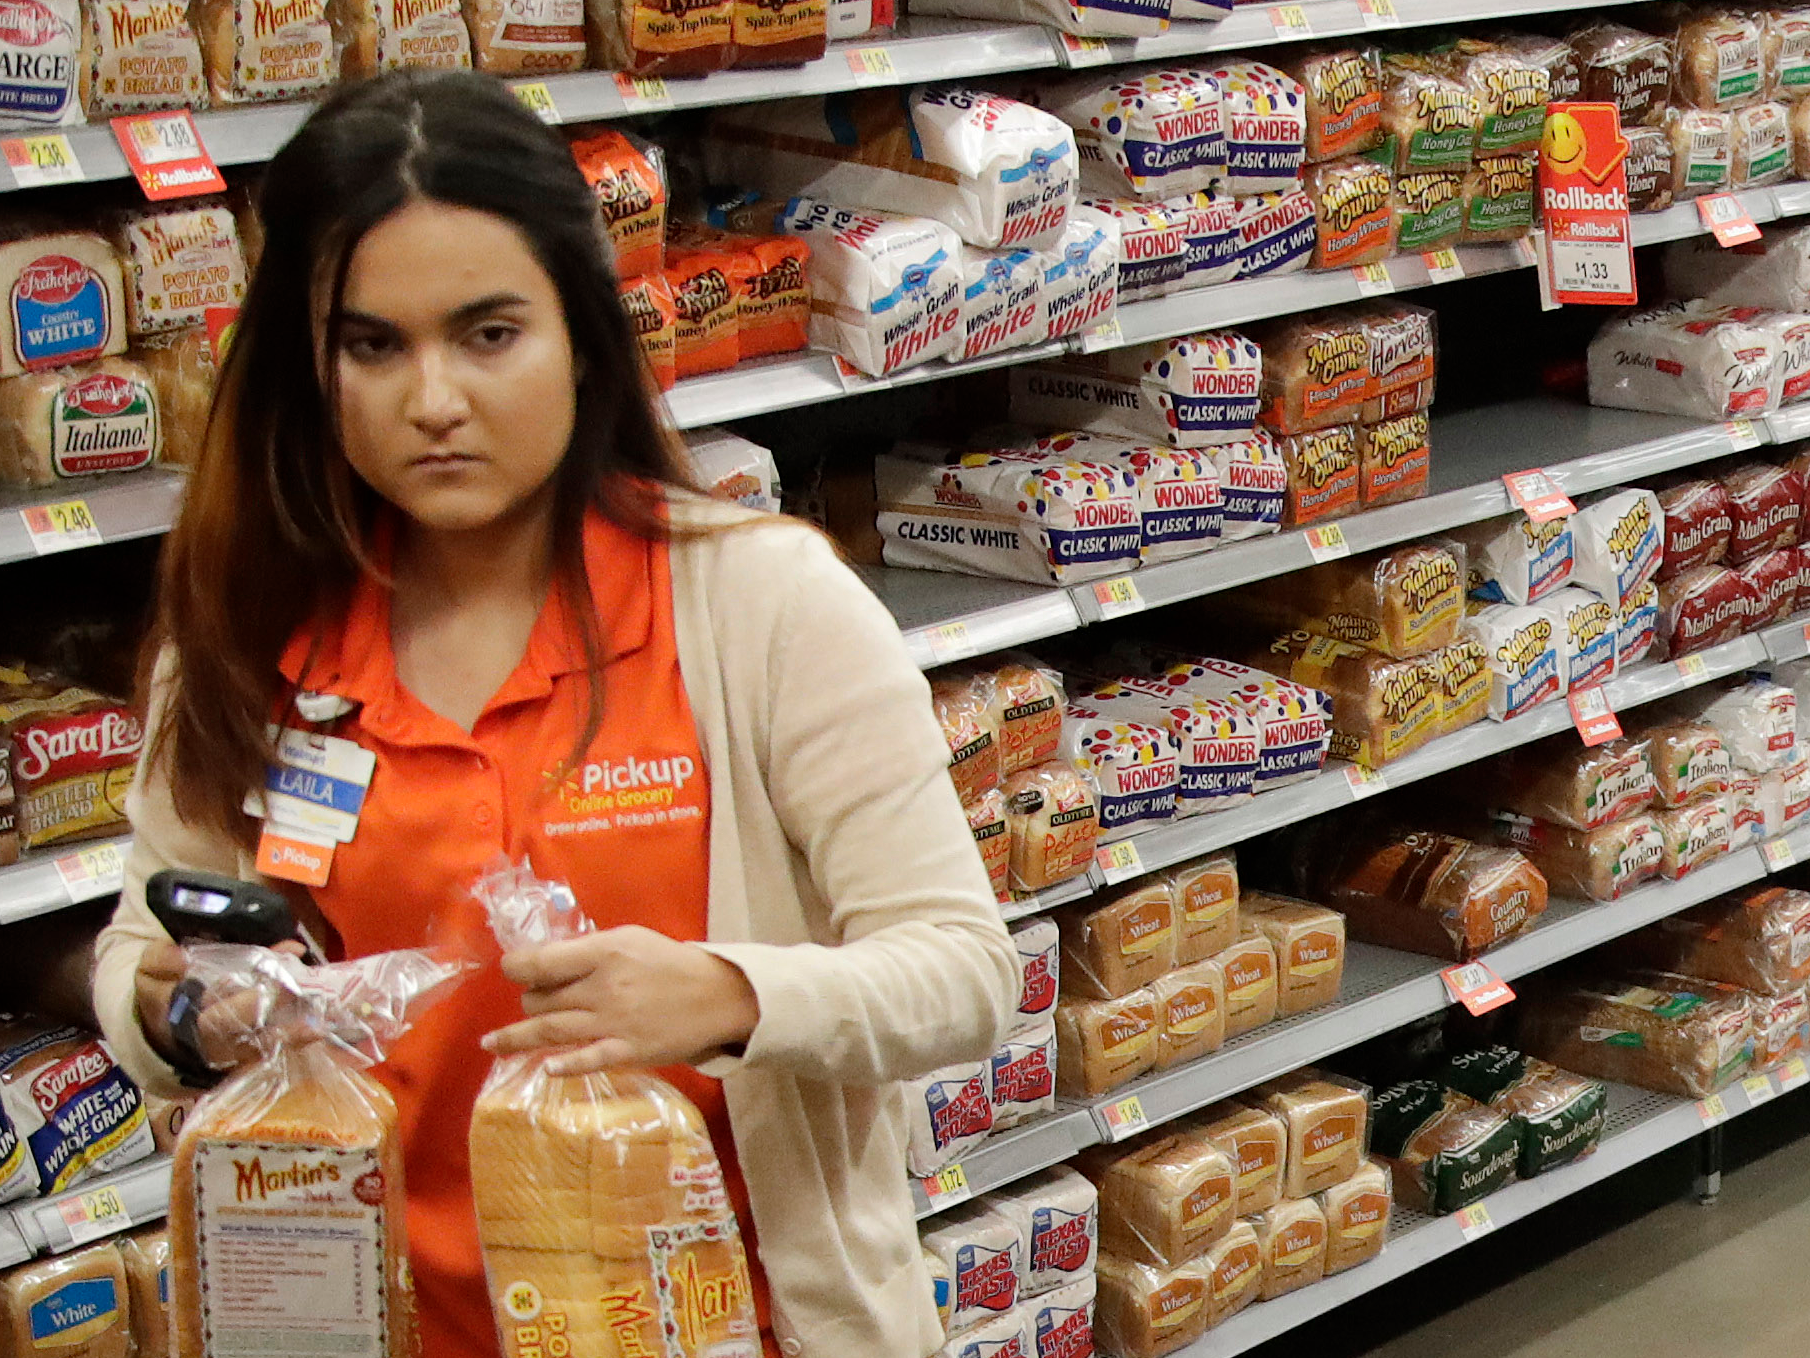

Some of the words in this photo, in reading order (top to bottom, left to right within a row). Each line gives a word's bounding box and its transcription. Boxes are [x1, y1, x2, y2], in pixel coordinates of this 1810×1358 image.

[260, 41, 322, 63] POTATO
[401, 35, 458, 55] POTATO
[0, 52, 68, 84] ARGE
[119, 56, 188, 74] POTATO
[263, 60, 319, 81] BREAD
[123, 77, 184, 94] BREAD
[1155, 108, 1220, 142] WONDER
[1231, 119, 1300, 142] WONDER
[1493, 116, 1526, 135] Honey
[1227, 149, 1266, 167] LASSIC
[160, 166, 216, 187] Rollback
[1628, 174, 1657, 193] Honey
[1005, 195, 1040, 219] Whole
[1041, 178, 1070, 204] Grain
[1480, 199, 1512, 218] Honey
[1544, 187, 1627, 210] Rollback
[1000, 205, 1066, 247] White
[1240, 195, 1314, 243] WONDER
[1412, 214, 1440, 233] Honey
[1570, 222, 1620, 237] Rollback
[20, 264, 90, 298] Freihofer's
[163, 266, 230, 291] POTATO
[1575, 262, 1609, 279] $1.33
[170, 286, 228, 309] BREAD
[965, 301, 1004, 335] Whole
[1006, 278, 1039, 309] Grain
[1047, 288, 1086, 318] Whole
[884, 308, 924, 345] Whole
[925, 282, 960, 315] Grain
[28, 317, 95, 346] WHITE
[883, 306, 960, 374] White
[964, 302, 1037, 359] White
[1369, 329, 1430, 376] Harvest
[1027, 379, 1091, 401] CLASSIC
[1097, 387, 1140, 410] WHITE
[1192, 371, 1257, 395] WONDER
[1178, 405, 1223, 422] CLASSIC
[1226, 404, 1258, 420] WHITE
[65, 417, 149, 453] Italiano!
[1155, 483, 1221, 508] WONDER
[1074, 501, 1139, 529] WONDER
[1739, 516, 1768, 540] Multi
[1769, 499, 1799, 525] Grain
[898, 521, 964, 547] CLASSIC
[969, 528, 1020, 550] WHITE
[1059, 535, 1103, 558] CLASSIC
[1671, 523, 1701, 551] Multi
[1702, 512, 1732, 536] Grain
[1742, 589, 1771, 615] Multi
[1771, 574, 1799, 598] Grain
[1567, 602, 1611, 636] Nature's
[1684, 609, 1714, 637] Multi
[1716, 594, 1744, 621] Grain
[1498, 619, 1552, 662] Nature's
[1437, 641, 1487, 675] Nature's
[1384, 663, 1438, 713] Nature's
[1005, 697, 1054, 720] OLDTYME
[18, 726, 98, 780] Sara
[101, 712, 142, 757] Lee
[1265, 720, 1324, 745] WONDER
[1193, 741, 1255, 764] WONDER
[583, 755, 695, 793] Pickup
[1117, 762, 1175, 793] WONDER
[1690, 757, 1727, 783] Italian
[23, 781, 98, 816] BUTTER
[280, 771, 334, 805] LAILA
[569, 794, 613, 813] Online
[616, 787, 674, 807] Grocery
[1600, 775, 1646, 804] Italian
[29, 801, 94, 833] BREAD
[616, 813, 655, 827] Pickup
[655, 811, 667, 822] in
[668, 806, 702, 821] store.
[1051, 805, 1093, 826] OLDTYME
[1044, 821, 1099, 856] Potato
[1690, 823, 1727, 854] Italian
[283, 846, 321, 872] Pickup
[1622, 841, 1662, 874] Italian
[1193, 890, 1222, 908] Wheat
[1490, 889, 1530, 922] Country
[1130, 919, 1161, 939] Wheat
[1494, 907, 1526, 937] Potato
[1299, 945, 1327, 961] Wheat
[1232, 969, 1261, 986] Wheat
[1172, 1000, 1206, 1020] Wheat
[998, 1046, 1049, 1083] TEXAS
[35, 1070, 78, 1113] Sara
[79, 1051, 107, 1084] Lee
[995, 1065, 1051, 1106] TOAST
[58, 1091, 105, 1133] WHITE
[935, 1077, 984, 1124] TEXAS
[44, 1125, 92, 1174] WHOLE
[91, 1087, 137, 1133] GRAIN
[938, 1098, 990, 1146] TOAST
[1541, 1108, 1602, 1154] Sourdough
[1313, 1131, 1343, 1149] Wheat
[232, 1155, 340, 1202] Martin's
[1460, 1140, 1519, 1190] Sourdough
[1192, 1192, 1219, 1213] Wheat
[1349, 1208, 1378, 1225] Wheat
[1035, 1215, 1086, 1249] TEXAS
[1286, 1234, 1311, 1251] Wheat
[1034, 1237, 1087, 1271] TOAST
[960, 1251, 1010, 1288] TEXAS
[1222, 1260, 1249, 1284] Wheat
[960, 1273, 1015, 1309] TOAST
[1161, 1291, 1193, 1313] Wheat
[51, 1302, 97, 1328] White
[1039, 1306, 1088, 1351] TEXAS
